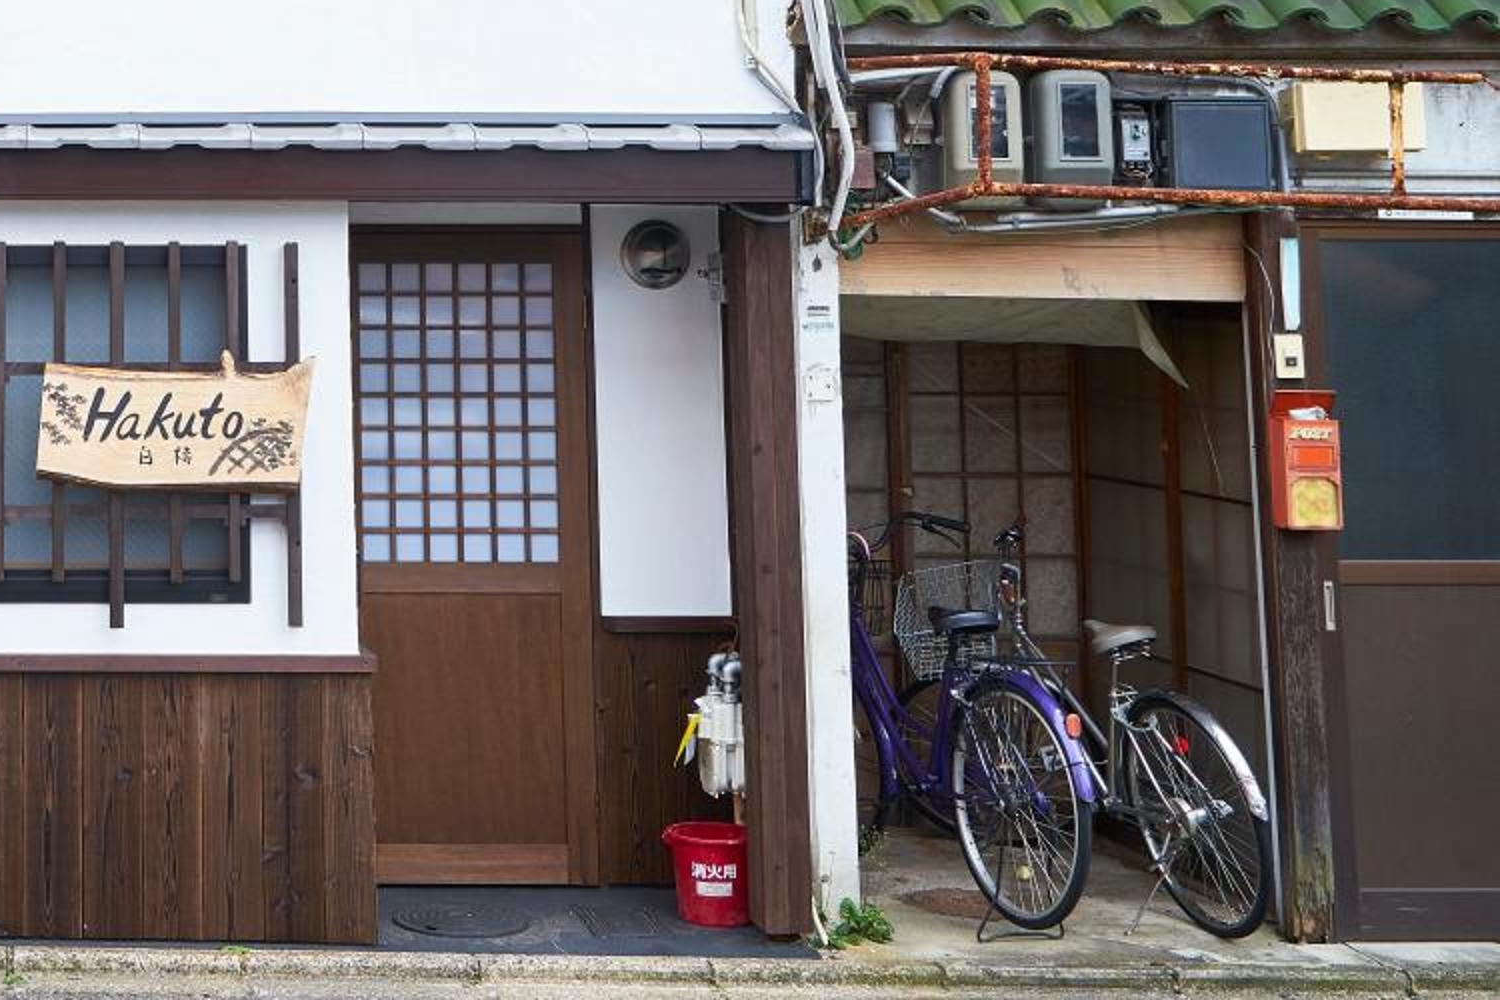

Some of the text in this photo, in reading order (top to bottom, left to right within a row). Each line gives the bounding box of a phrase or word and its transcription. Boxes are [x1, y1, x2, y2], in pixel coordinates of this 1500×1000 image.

[82, 386, 245, 442] Hakuto
[691, 861, 737, 880] 消火用
